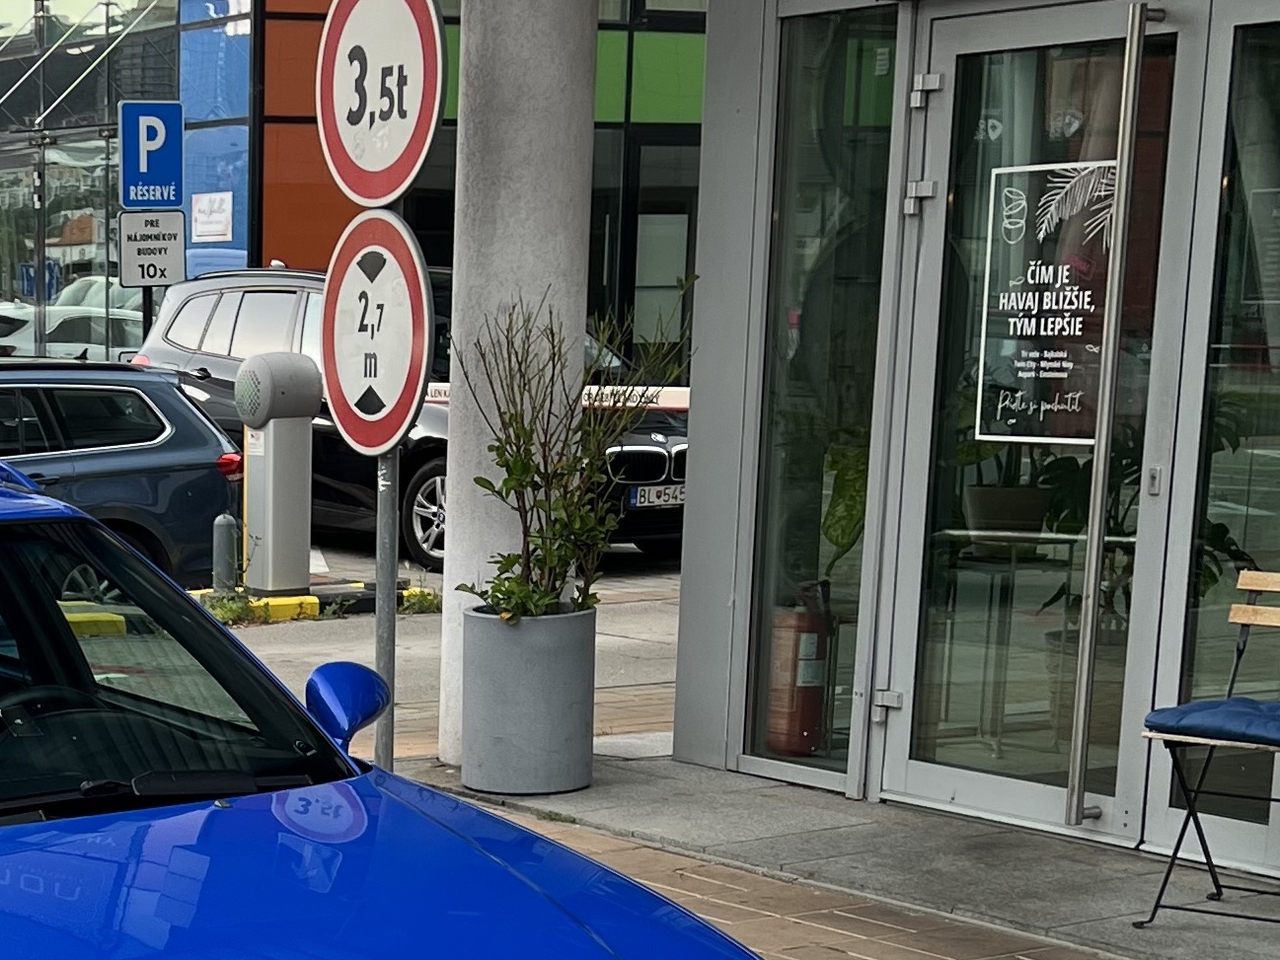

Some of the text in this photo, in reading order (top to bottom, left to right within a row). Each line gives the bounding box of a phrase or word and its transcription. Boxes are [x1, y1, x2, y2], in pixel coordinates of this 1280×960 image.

[346, 45, 408, 131] 3,5t
[138, 115, 167, 173] P
[129, 181, 176, 200] RÉSERVÉ
[145, 219, 160, 228] PRE
[126, 231, 178, 242] NÁJOMNÍKOV
[137, 247, 169, 256] BUDOVY
[138, 263, 167, 279] 10x
[1027, 260, 1054, 284] ČÍM
[1055, 264, 1071, 288] JE
[999, 285, 1096, 315] HAVAJ BLIŽŠIE,
[358, 290, 385, 340] 2,7
[1008, 312, 1084, 336] TÝM LEPŠIE
[363, 352, 378, 378] m
[639, 487, 655, 504] BL
